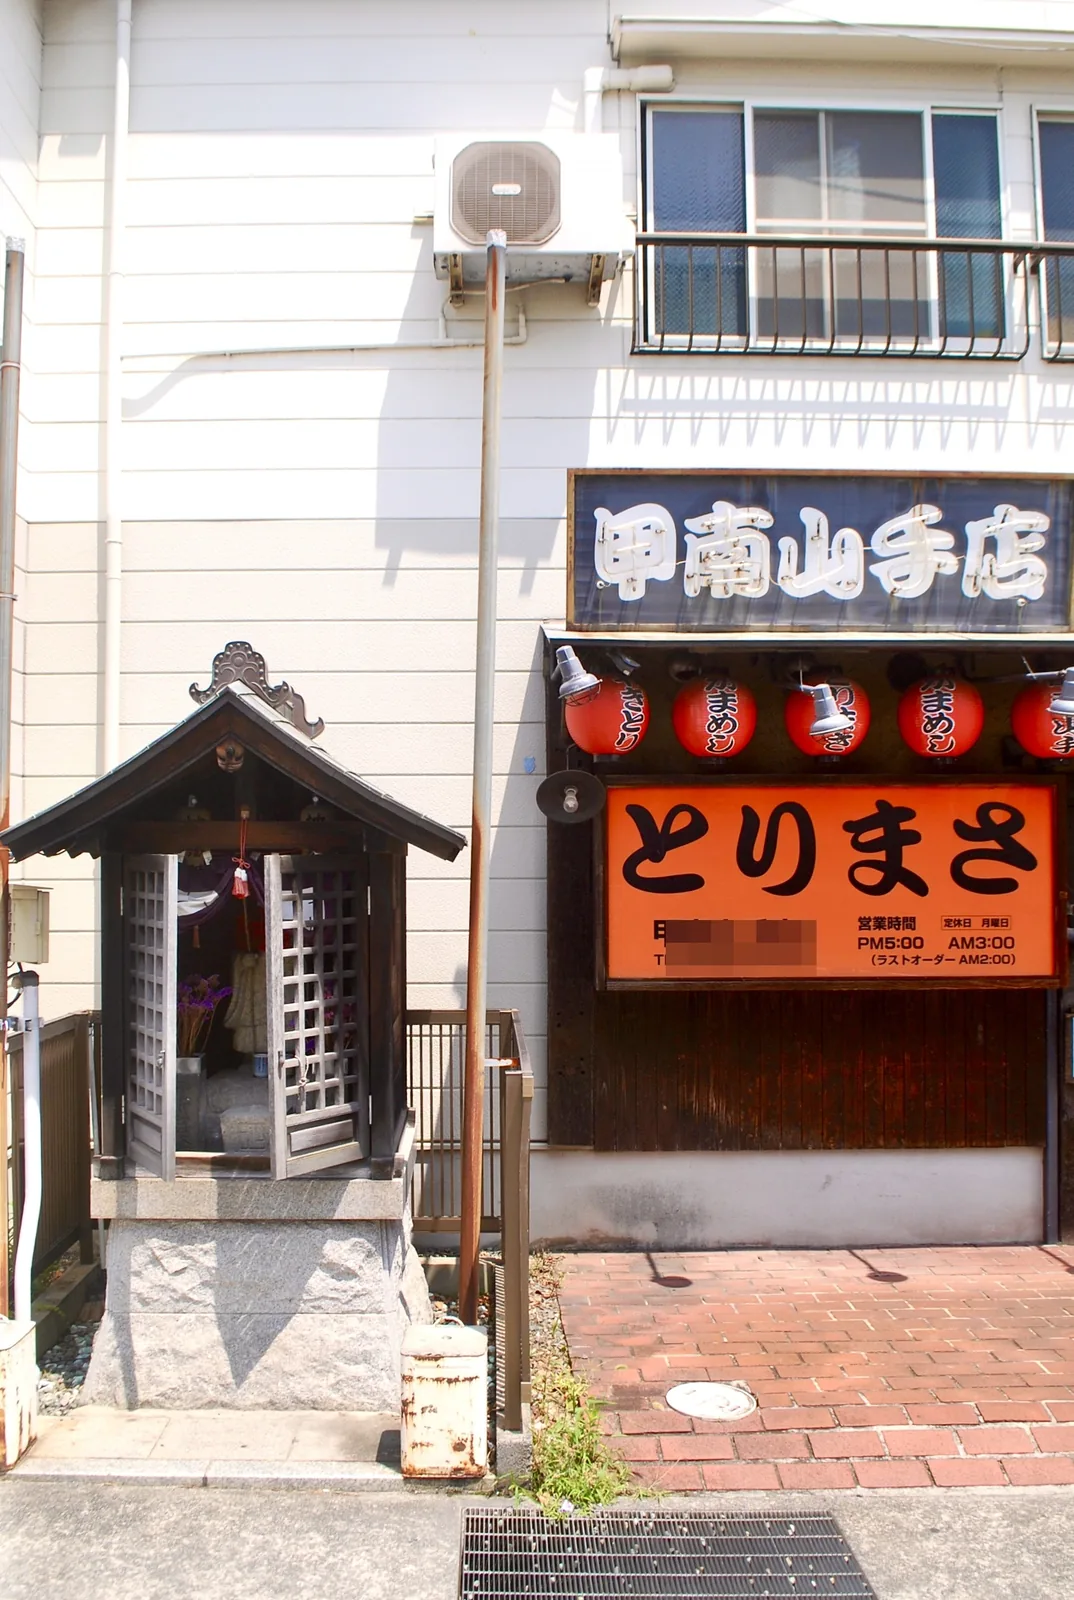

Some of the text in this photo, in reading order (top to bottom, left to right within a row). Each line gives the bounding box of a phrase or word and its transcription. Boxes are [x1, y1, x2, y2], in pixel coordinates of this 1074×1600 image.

[594, 501, 1050, 601] 甲南山手店
[622, 799, 1038, 898] とりまさ
[858, 916, 917, 931] 営業時間
[944, 918, 1009, 928] 定休日 月曜日
[858, 936, 1015, 950] PM5:00 AM3:00
